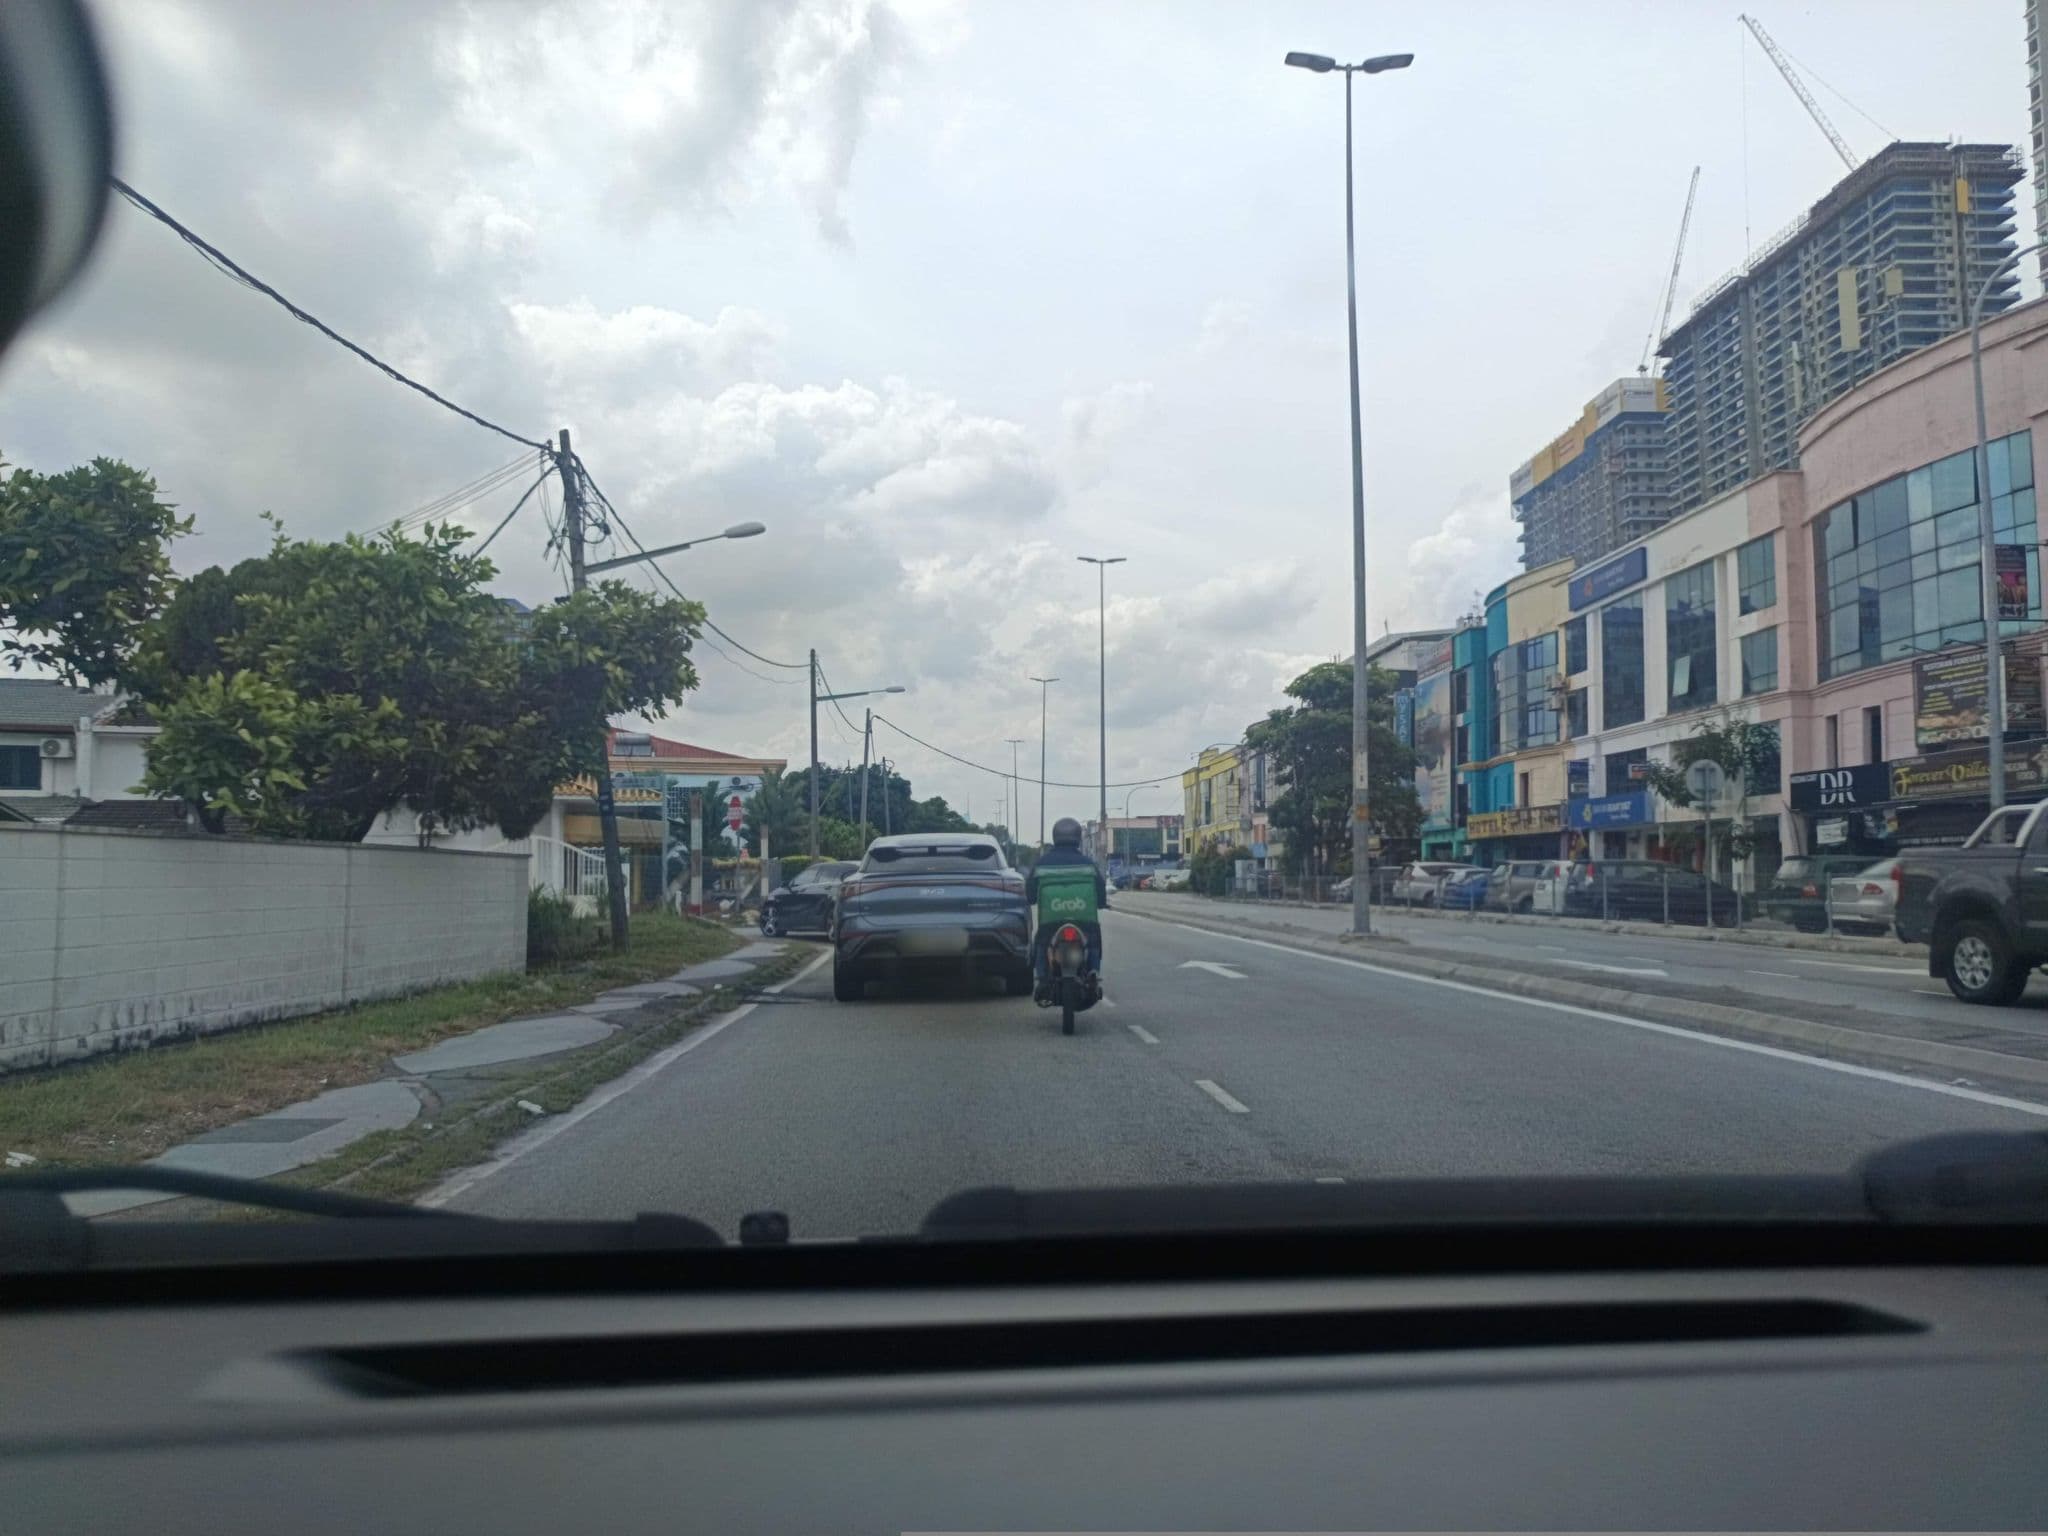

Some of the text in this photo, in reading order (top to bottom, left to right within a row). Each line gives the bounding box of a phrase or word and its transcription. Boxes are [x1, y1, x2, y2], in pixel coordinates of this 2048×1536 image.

[1820, 770, 1856, 805] DR
[1894, 767, 1945, 797] Forever
[1468, 818, 1501, 835] HOTEL
[1051, 897, 1087, 911] Grab
